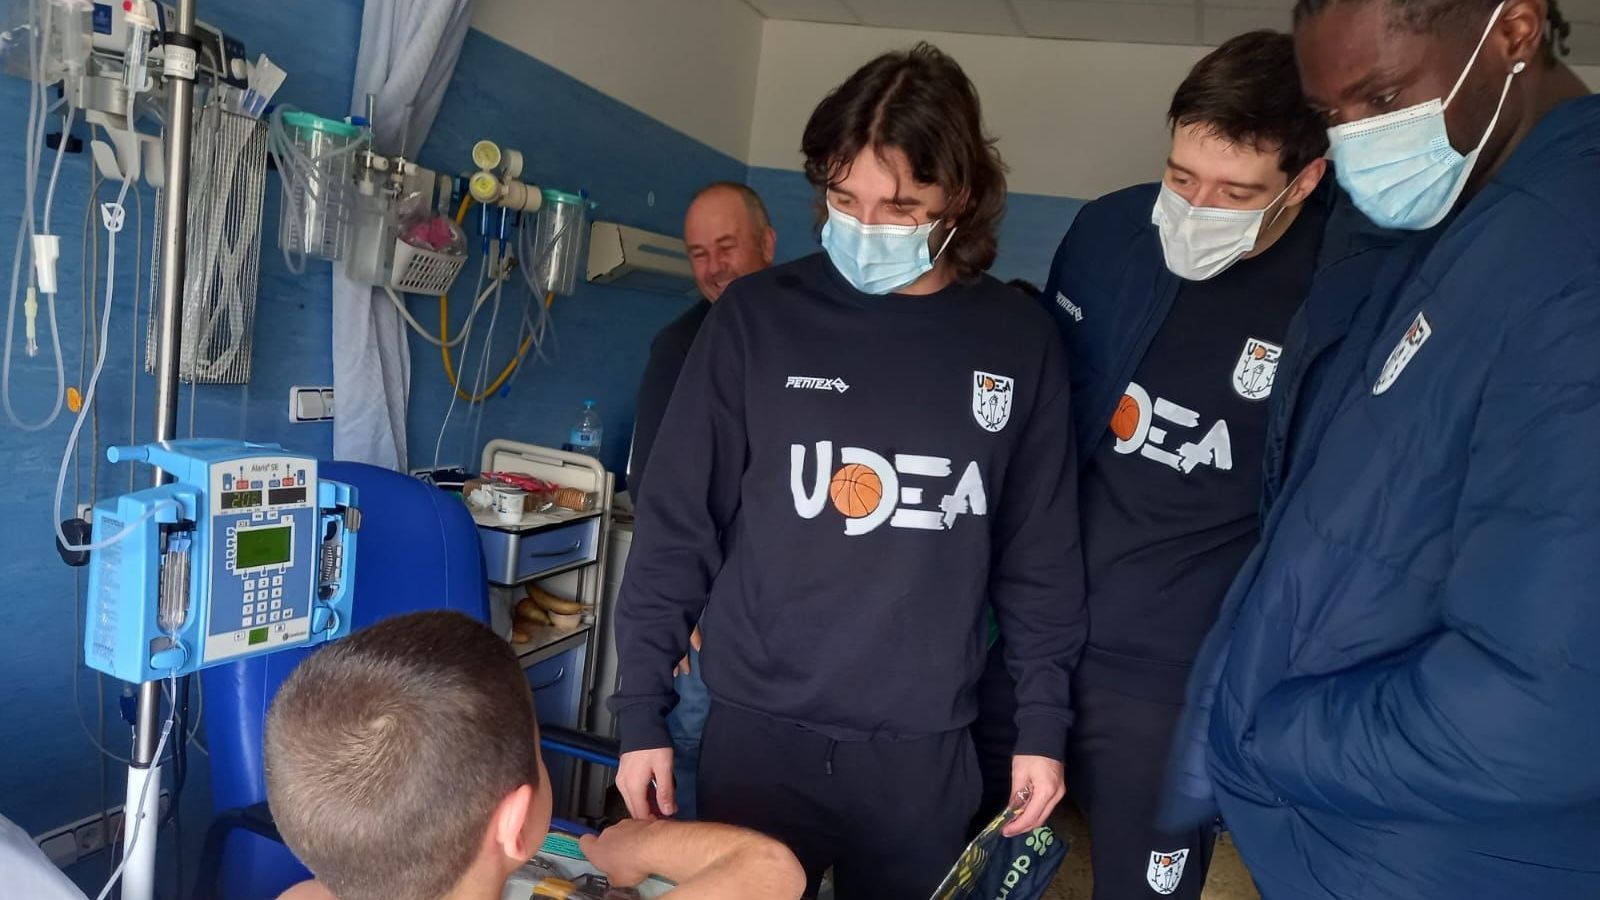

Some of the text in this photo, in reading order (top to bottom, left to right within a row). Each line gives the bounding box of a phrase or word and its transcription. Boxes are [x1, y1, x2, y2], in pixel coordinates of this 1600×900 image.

[786, 376, 834, 391] PENTEX
[976, 374, 1011, 393] UDEA
[1109, 381, 1233, 475] DEA
[790, 440, 988, 536] UDEA
[1153, 852, 1184, 867] UDEA
